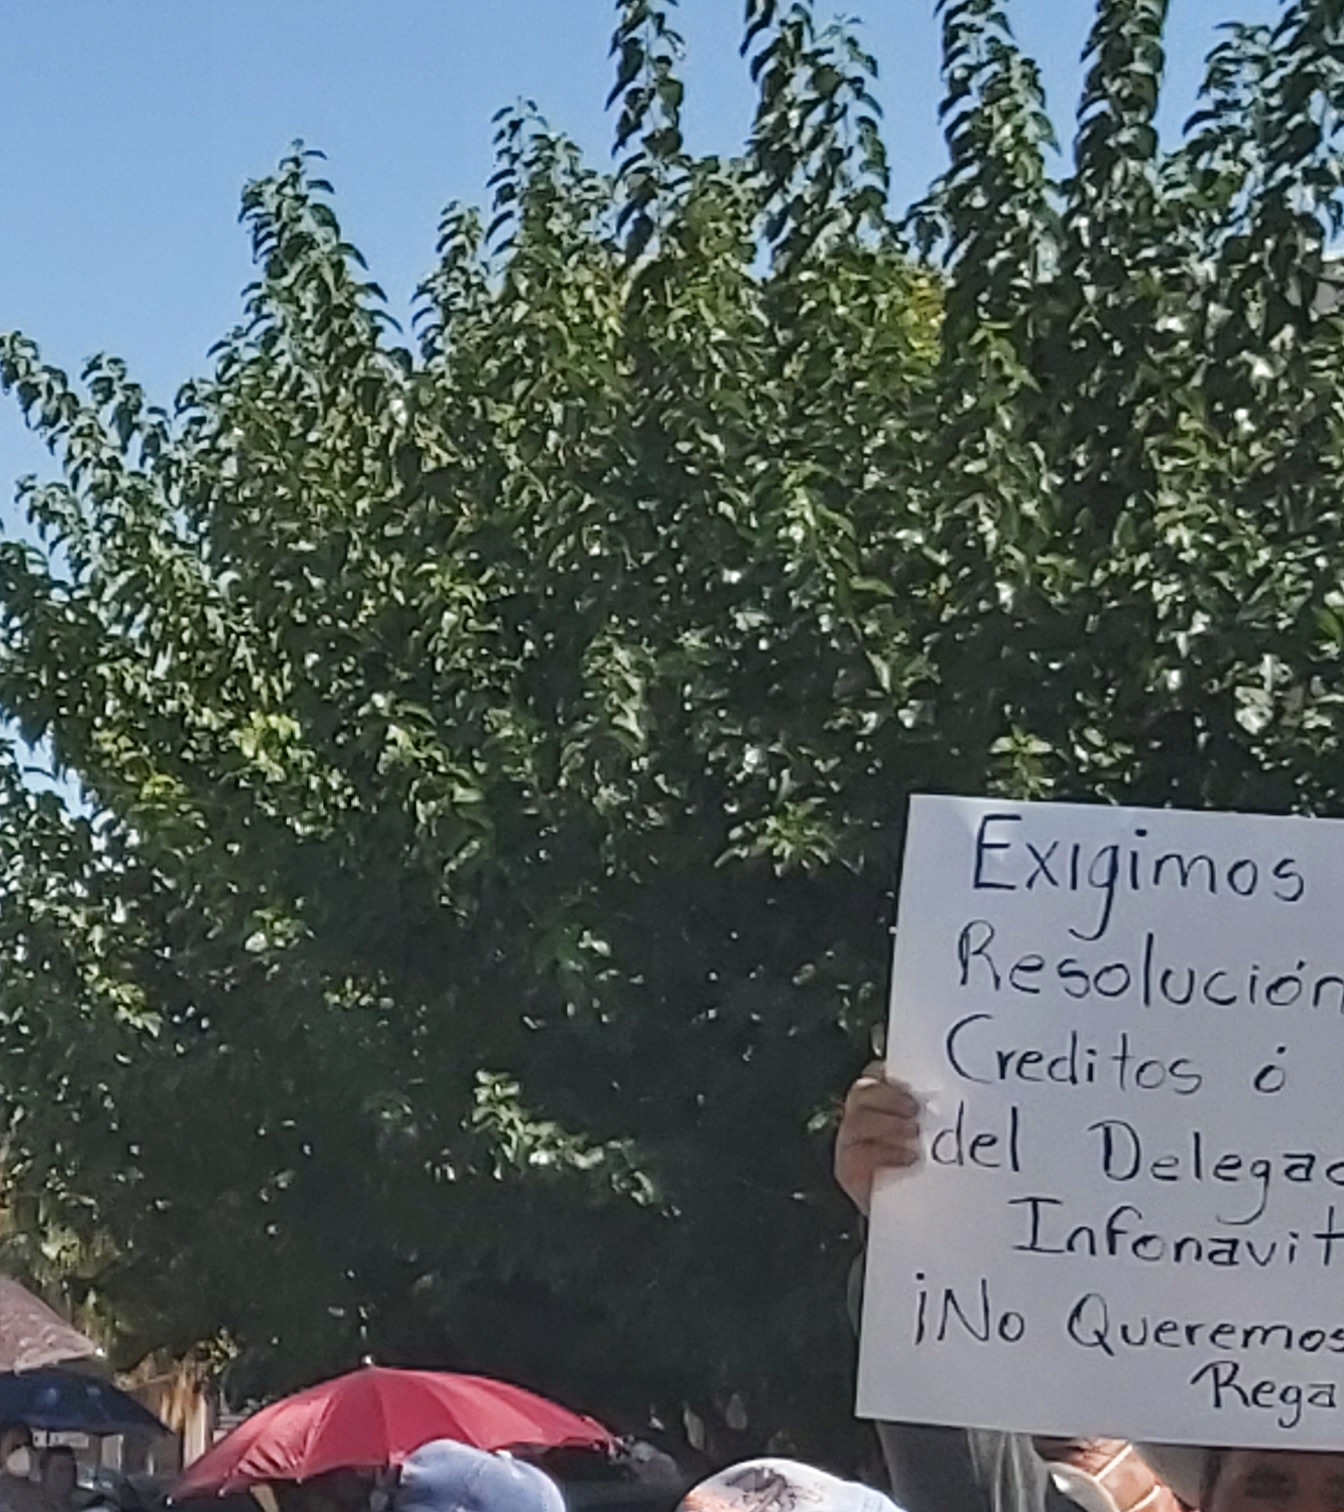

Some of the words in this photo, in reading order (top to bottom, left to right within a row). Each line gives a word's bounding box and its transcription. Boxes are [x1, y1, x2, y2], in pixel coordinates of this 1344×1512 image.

[972, 813, 1306, 942] Exigimos
[957, 919, 1344, 1010] Resolución
[945, 1013, 1204, 1095] Creditos
[930, 1100, 1022, 1175] del
